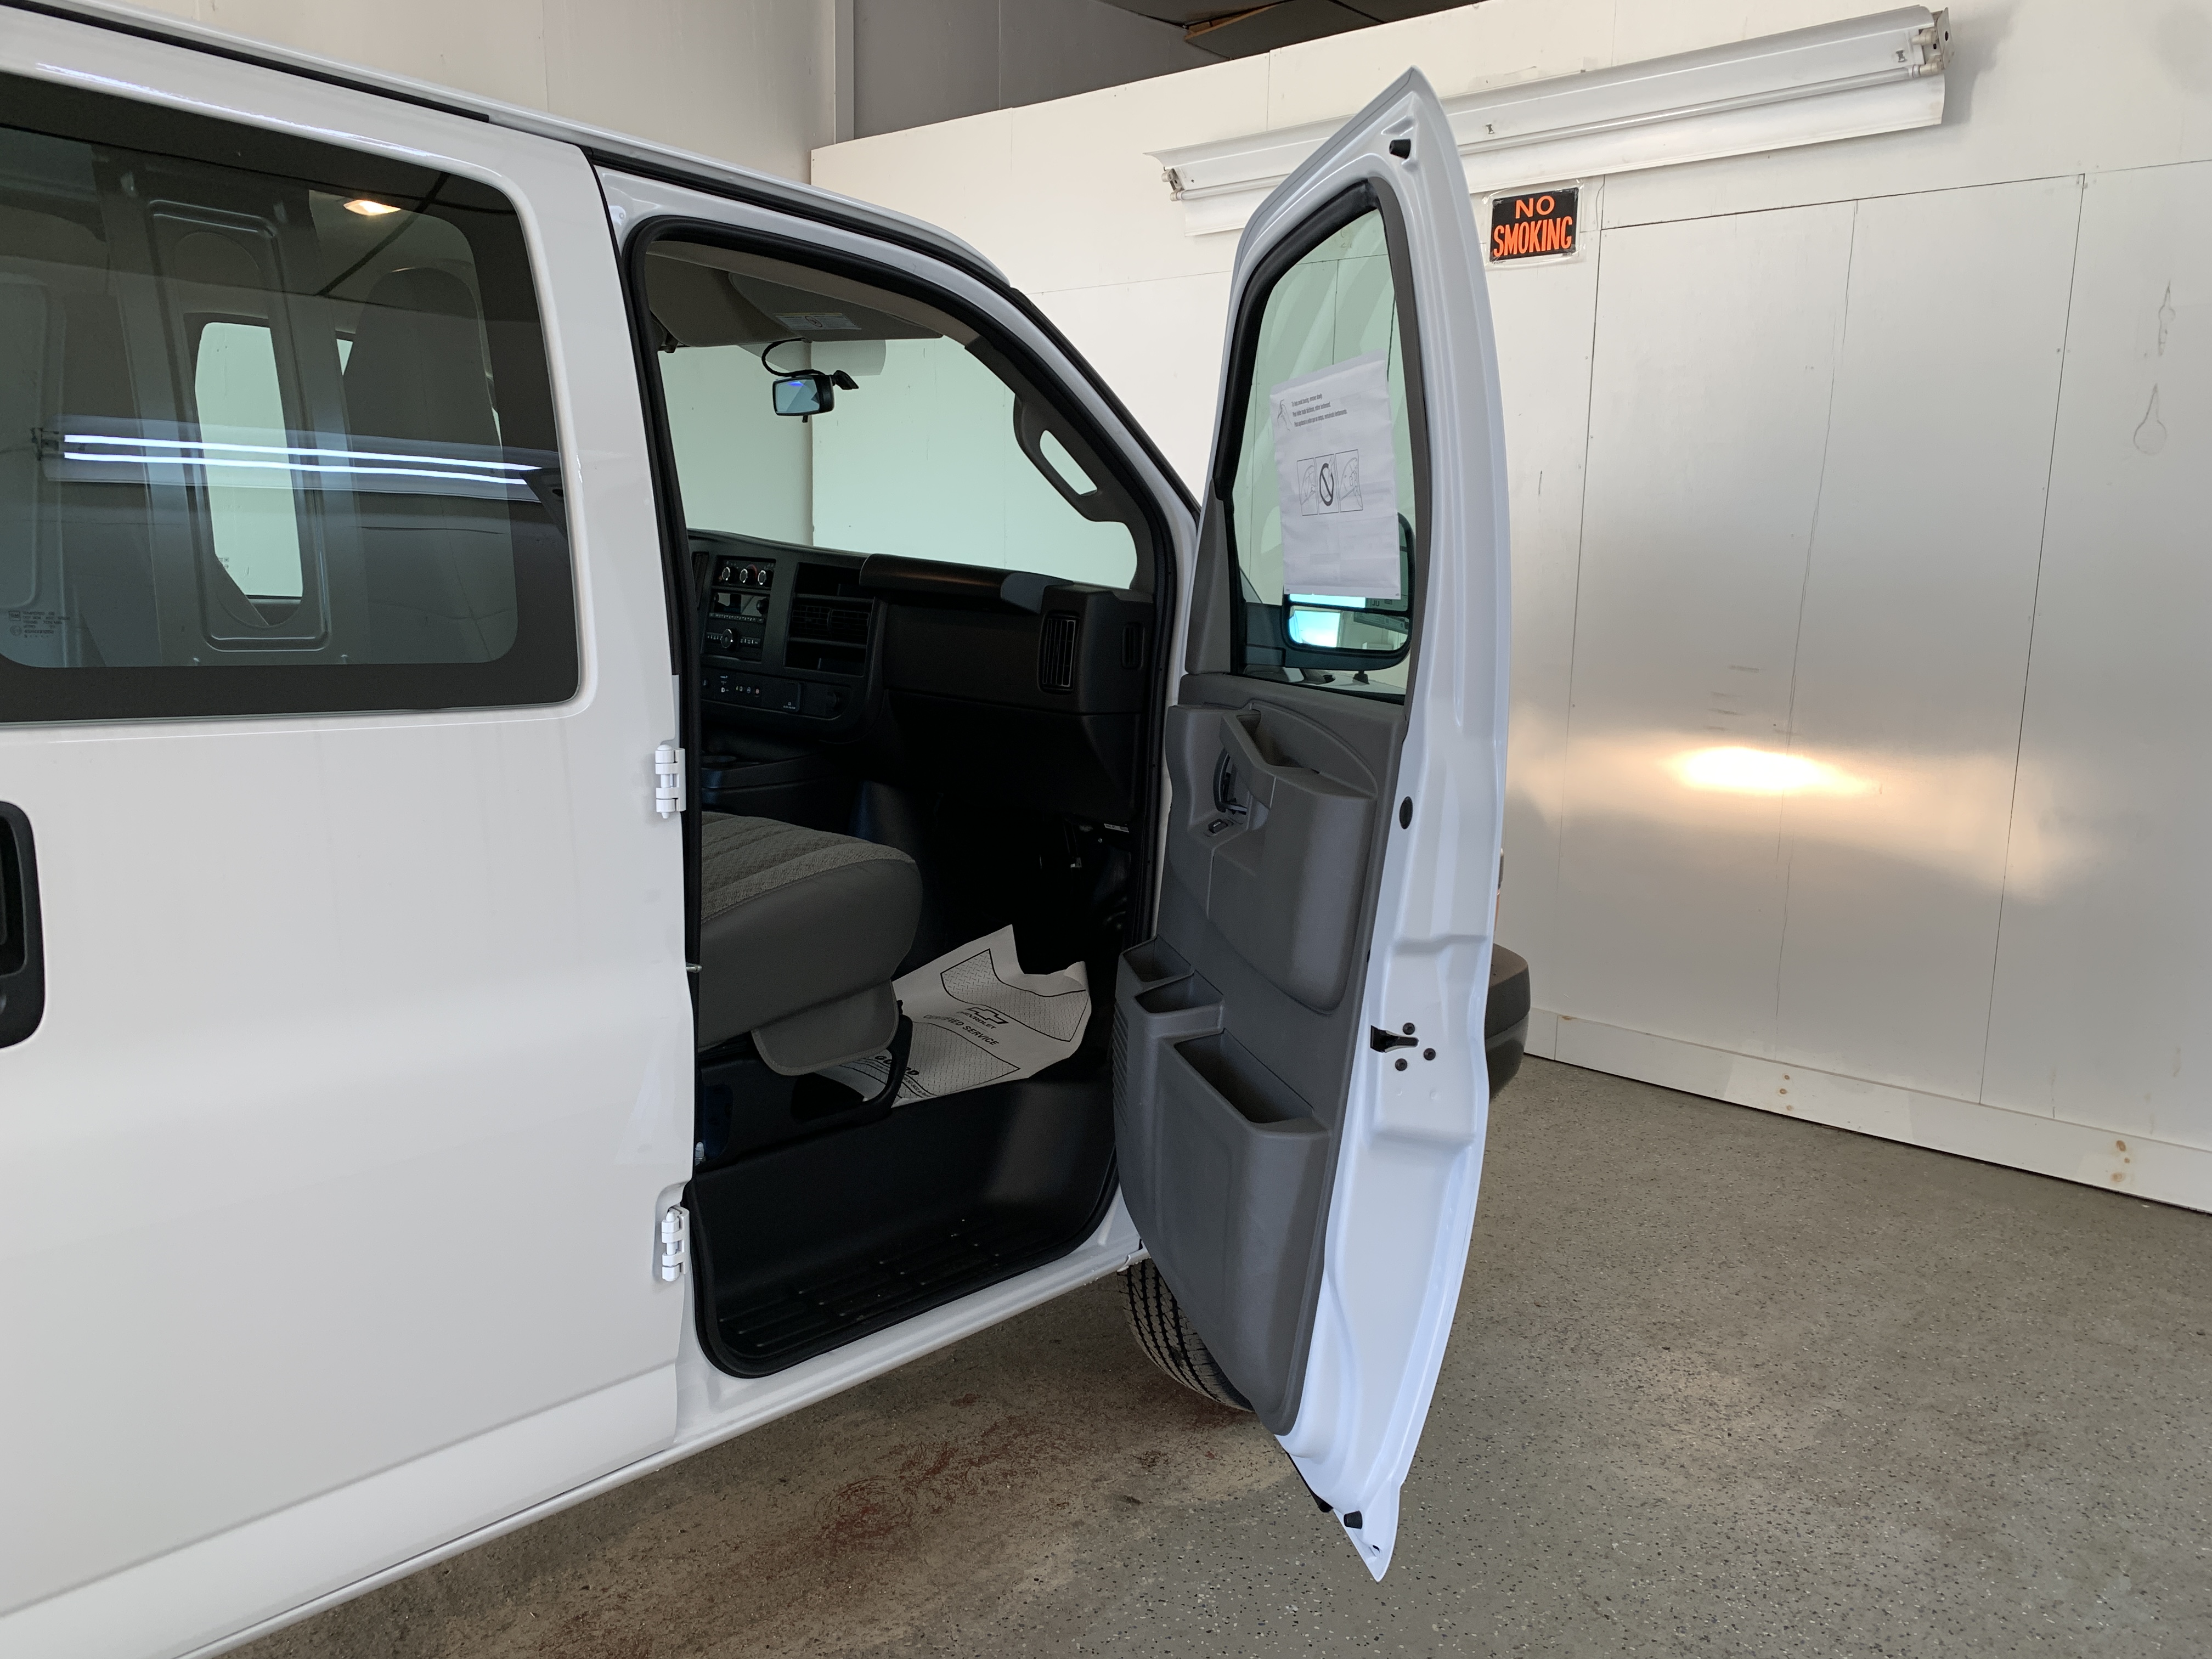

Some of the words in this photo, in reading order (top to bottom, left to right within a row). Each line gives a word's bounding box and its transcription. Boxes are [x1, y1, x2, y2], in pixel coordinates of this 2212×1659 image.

[1515, 195, 1555, 219] NO
[1493, 216, 1573, 257] SMOKING
[956, 1011, 997, 1030] CHEVROLET
[962, 1025, 1000, 1046] SERVICE
